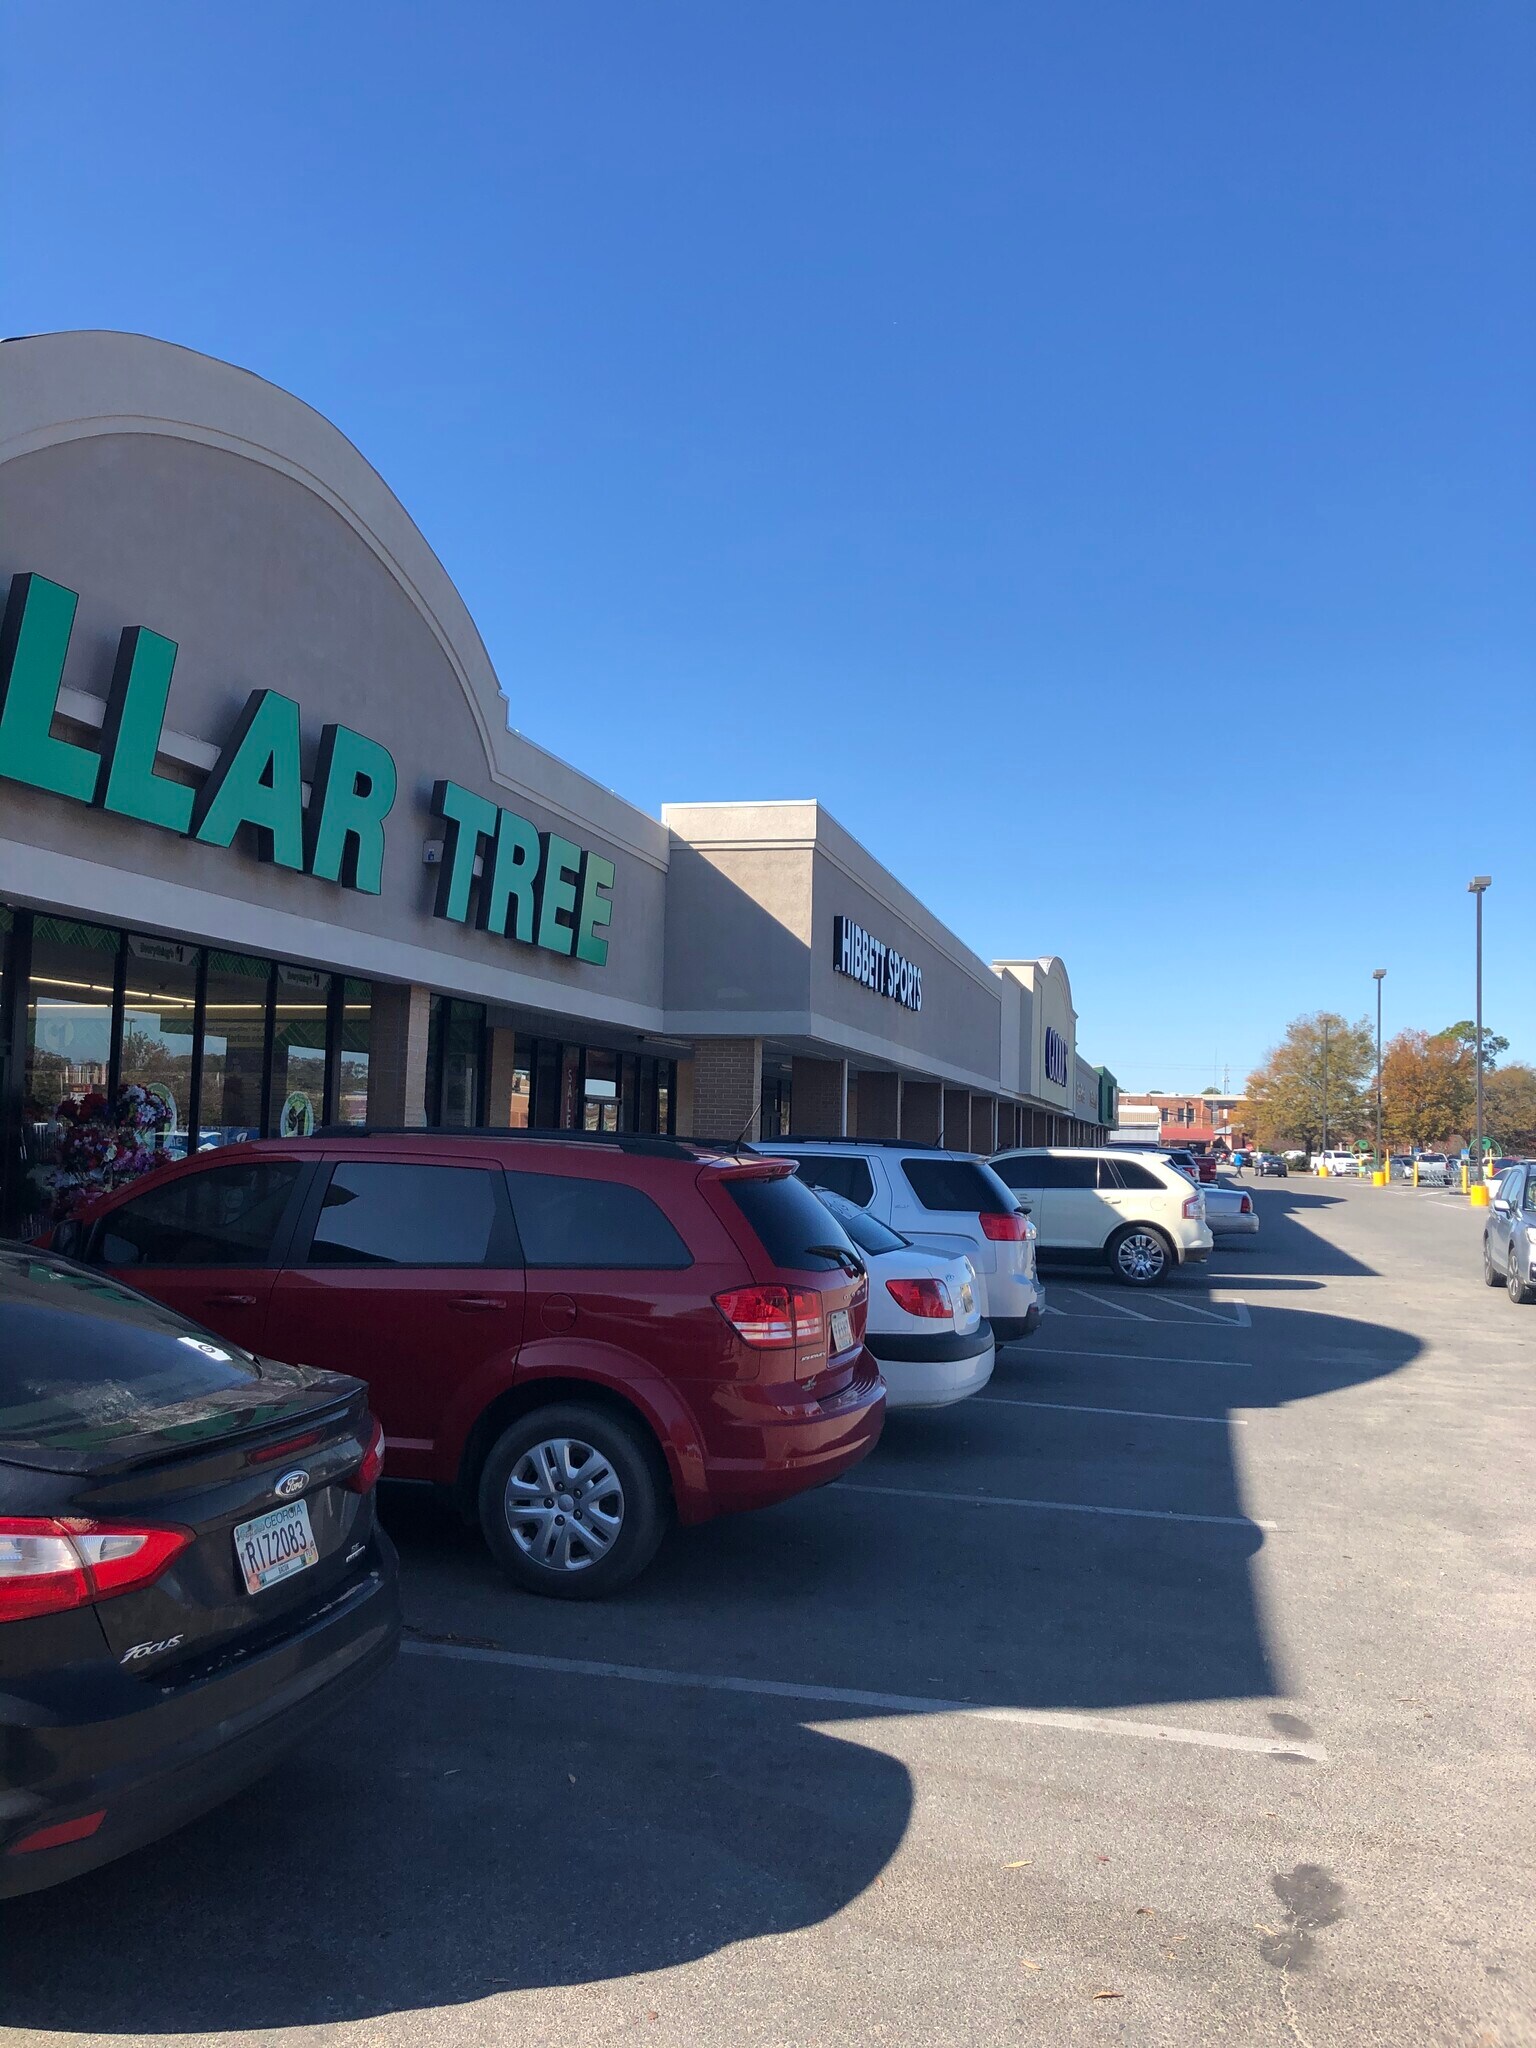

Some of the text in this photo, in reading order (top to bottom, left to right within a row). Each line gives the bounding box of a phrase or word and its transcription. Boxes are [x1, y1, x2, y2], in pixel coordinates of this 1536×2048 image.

[0, 571, 615, 967] LLAR TREE
[840, 915, 922, 1012] HIBBETT SPORTS
[246, 1520, 307, 1574] RIZ2083
[264, 1504, 303, 1529] GEORGIA
